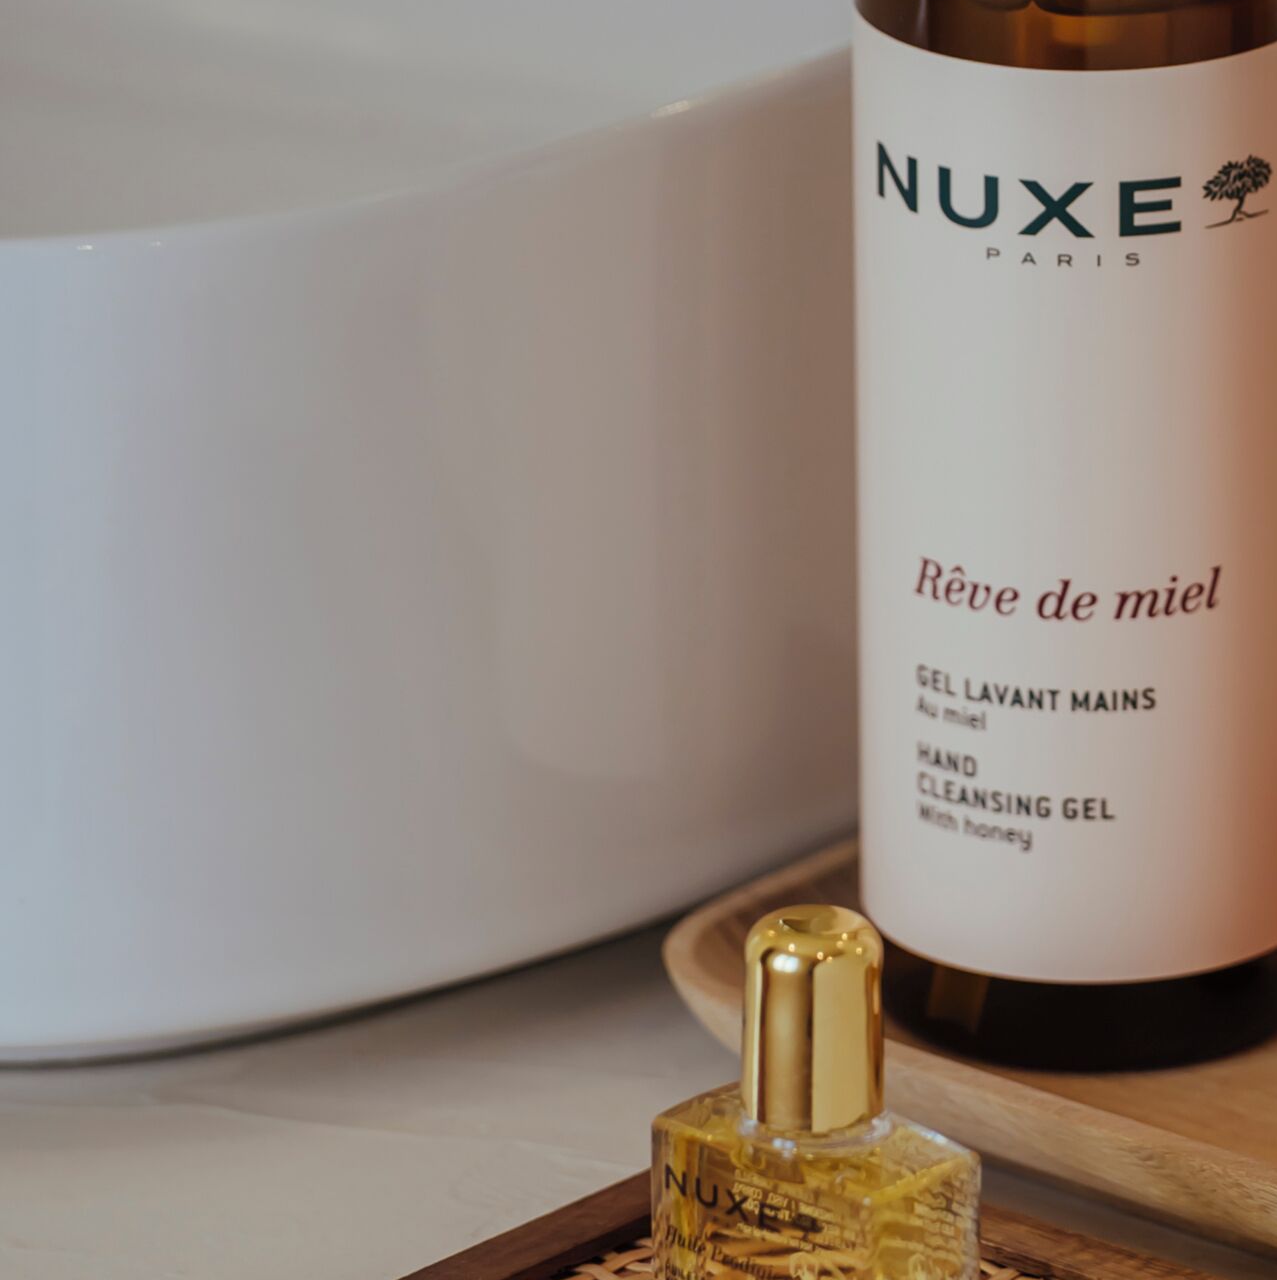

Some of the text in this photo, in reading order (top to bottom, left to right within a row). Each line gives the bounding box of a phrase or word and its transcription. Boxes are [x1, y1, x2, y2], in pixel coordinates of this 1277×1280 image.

[877, 140, 1182, 238] NUXE
[986, 247, 1141, 268] PARIS
[914, 556, 1222, 621] Rêve de miel
[916, 664, 1157, 712] GEL LAVANT MAINS
[916, 696, 987, 731] Au miel
[917, 741, 978, 778] HAND
[917, 772, 1116, 821] CLEANSING GEL
[918, 802, 1033, 852] With honey
[665, 1163, 783, 1232] NUXE
